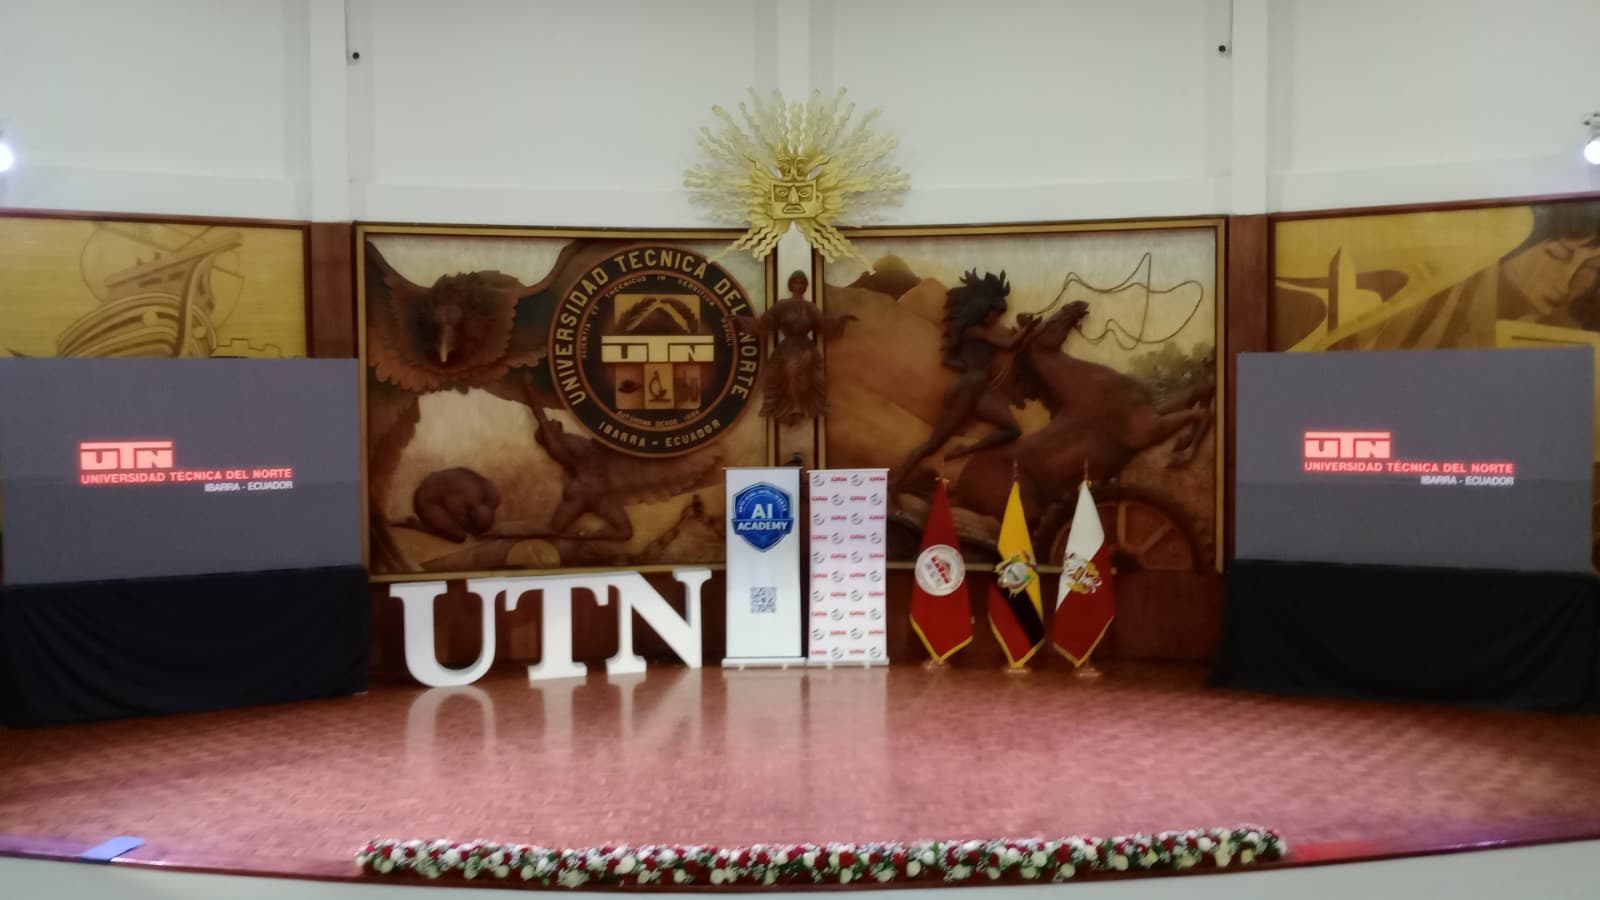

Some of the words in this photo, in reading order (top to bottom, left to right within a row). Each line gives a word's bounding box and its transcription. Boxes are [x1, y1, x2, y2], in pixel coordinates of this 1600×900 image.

[555, 267, 609, 406] UNIVERSIDAD
[614, 249, 707, 279] TECNICA
[713, 278, 746, 317] DEL
[731, 331, 758, 400] NORTE
[601, 335, 715, 363] UTN
[599, 421, 646, 448] IBARRA
[665, 419, 721, 448] ECUADOR
[1304, 431, 1391, 458] UTN
[80, 441, 174, 470] UTN
[80, 471, 166, 485] UNIVERSIDAD
[226, 469, 249, 480] DEL
[253, 468, 293, 479] NORTE
[1304, 461, 1383, 472] UNIVERSIDAD
[1443, 463, 1467, 473] DEL
[1471, 463, 1514, 473] NORTE
[204, 483, 240, 492] IBARRA
[248, 481, 293, 491] ECUADOR
[1420, 476, 1457, 485] IBARRA
[1464, 476, 1514, 486] ECUADOR
[751, 503, 774, 519] AI
[737, 522, 788, 531] ACADEMY
[390, 568, 712, 687] UTN
